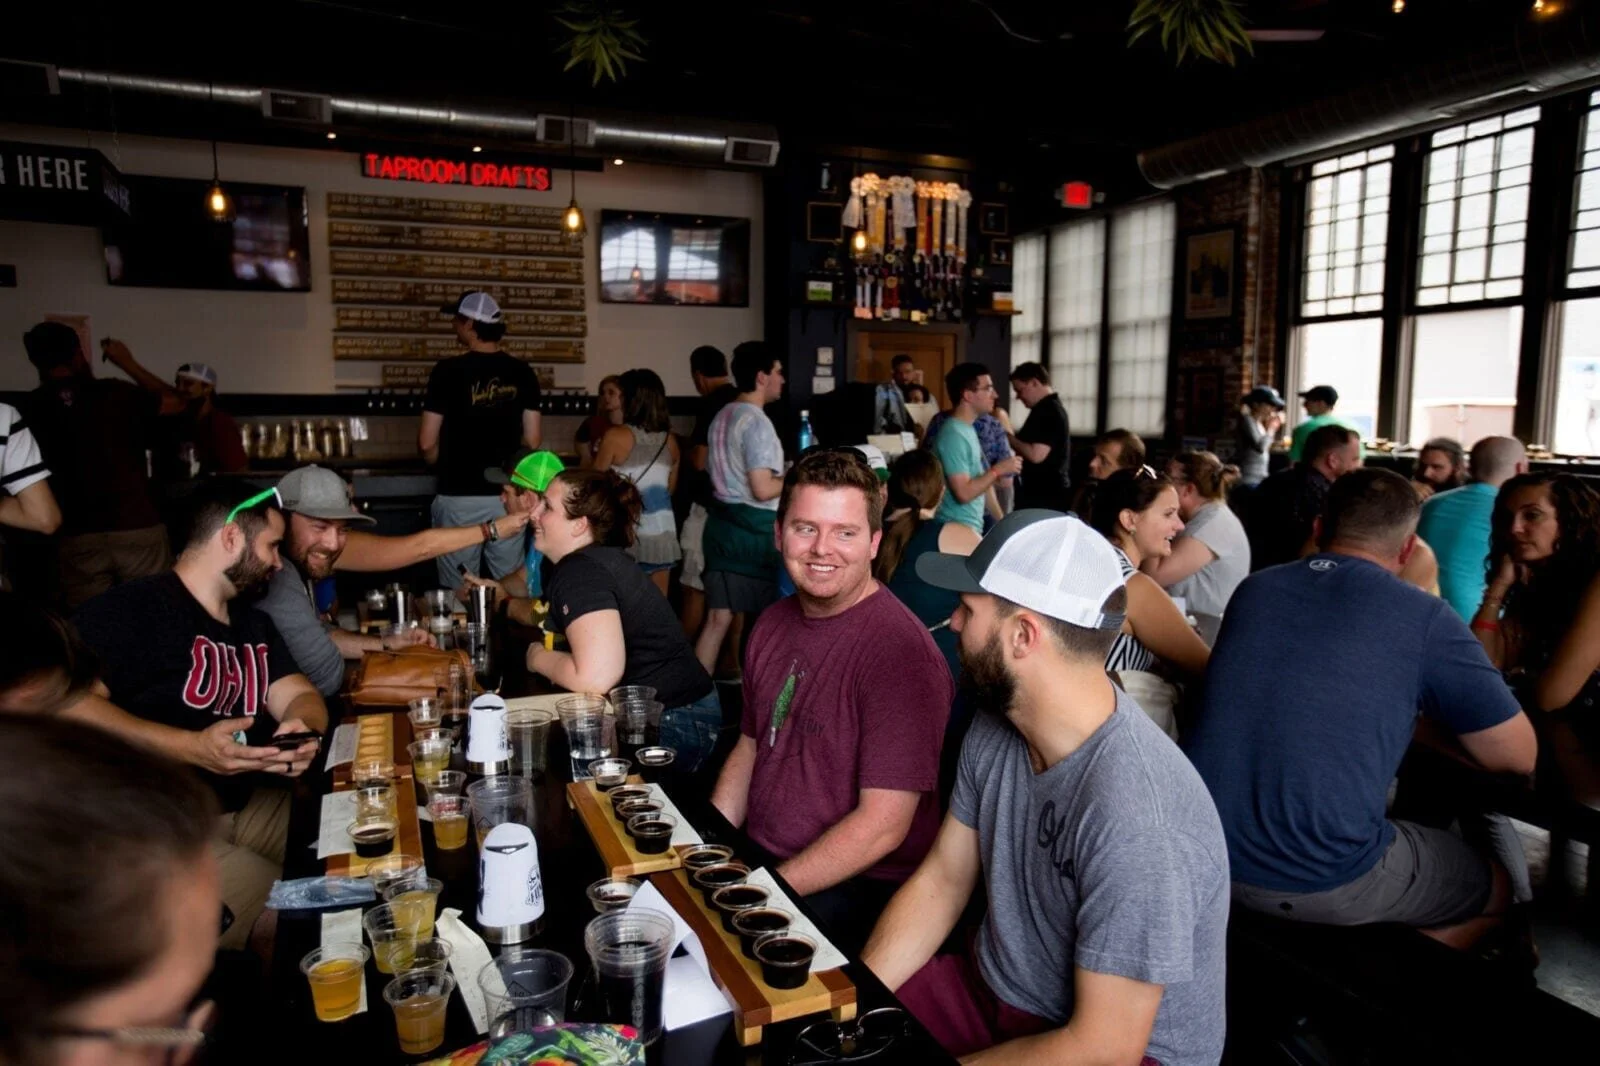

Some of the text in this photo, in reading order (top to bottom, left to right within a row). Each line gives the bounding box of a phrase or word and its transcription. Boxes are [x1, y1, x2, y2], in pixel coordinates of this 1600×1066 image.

[17, 154, 89, 191] HERE
[365, 152, 550, 192] TAPROOM DRAFTS
